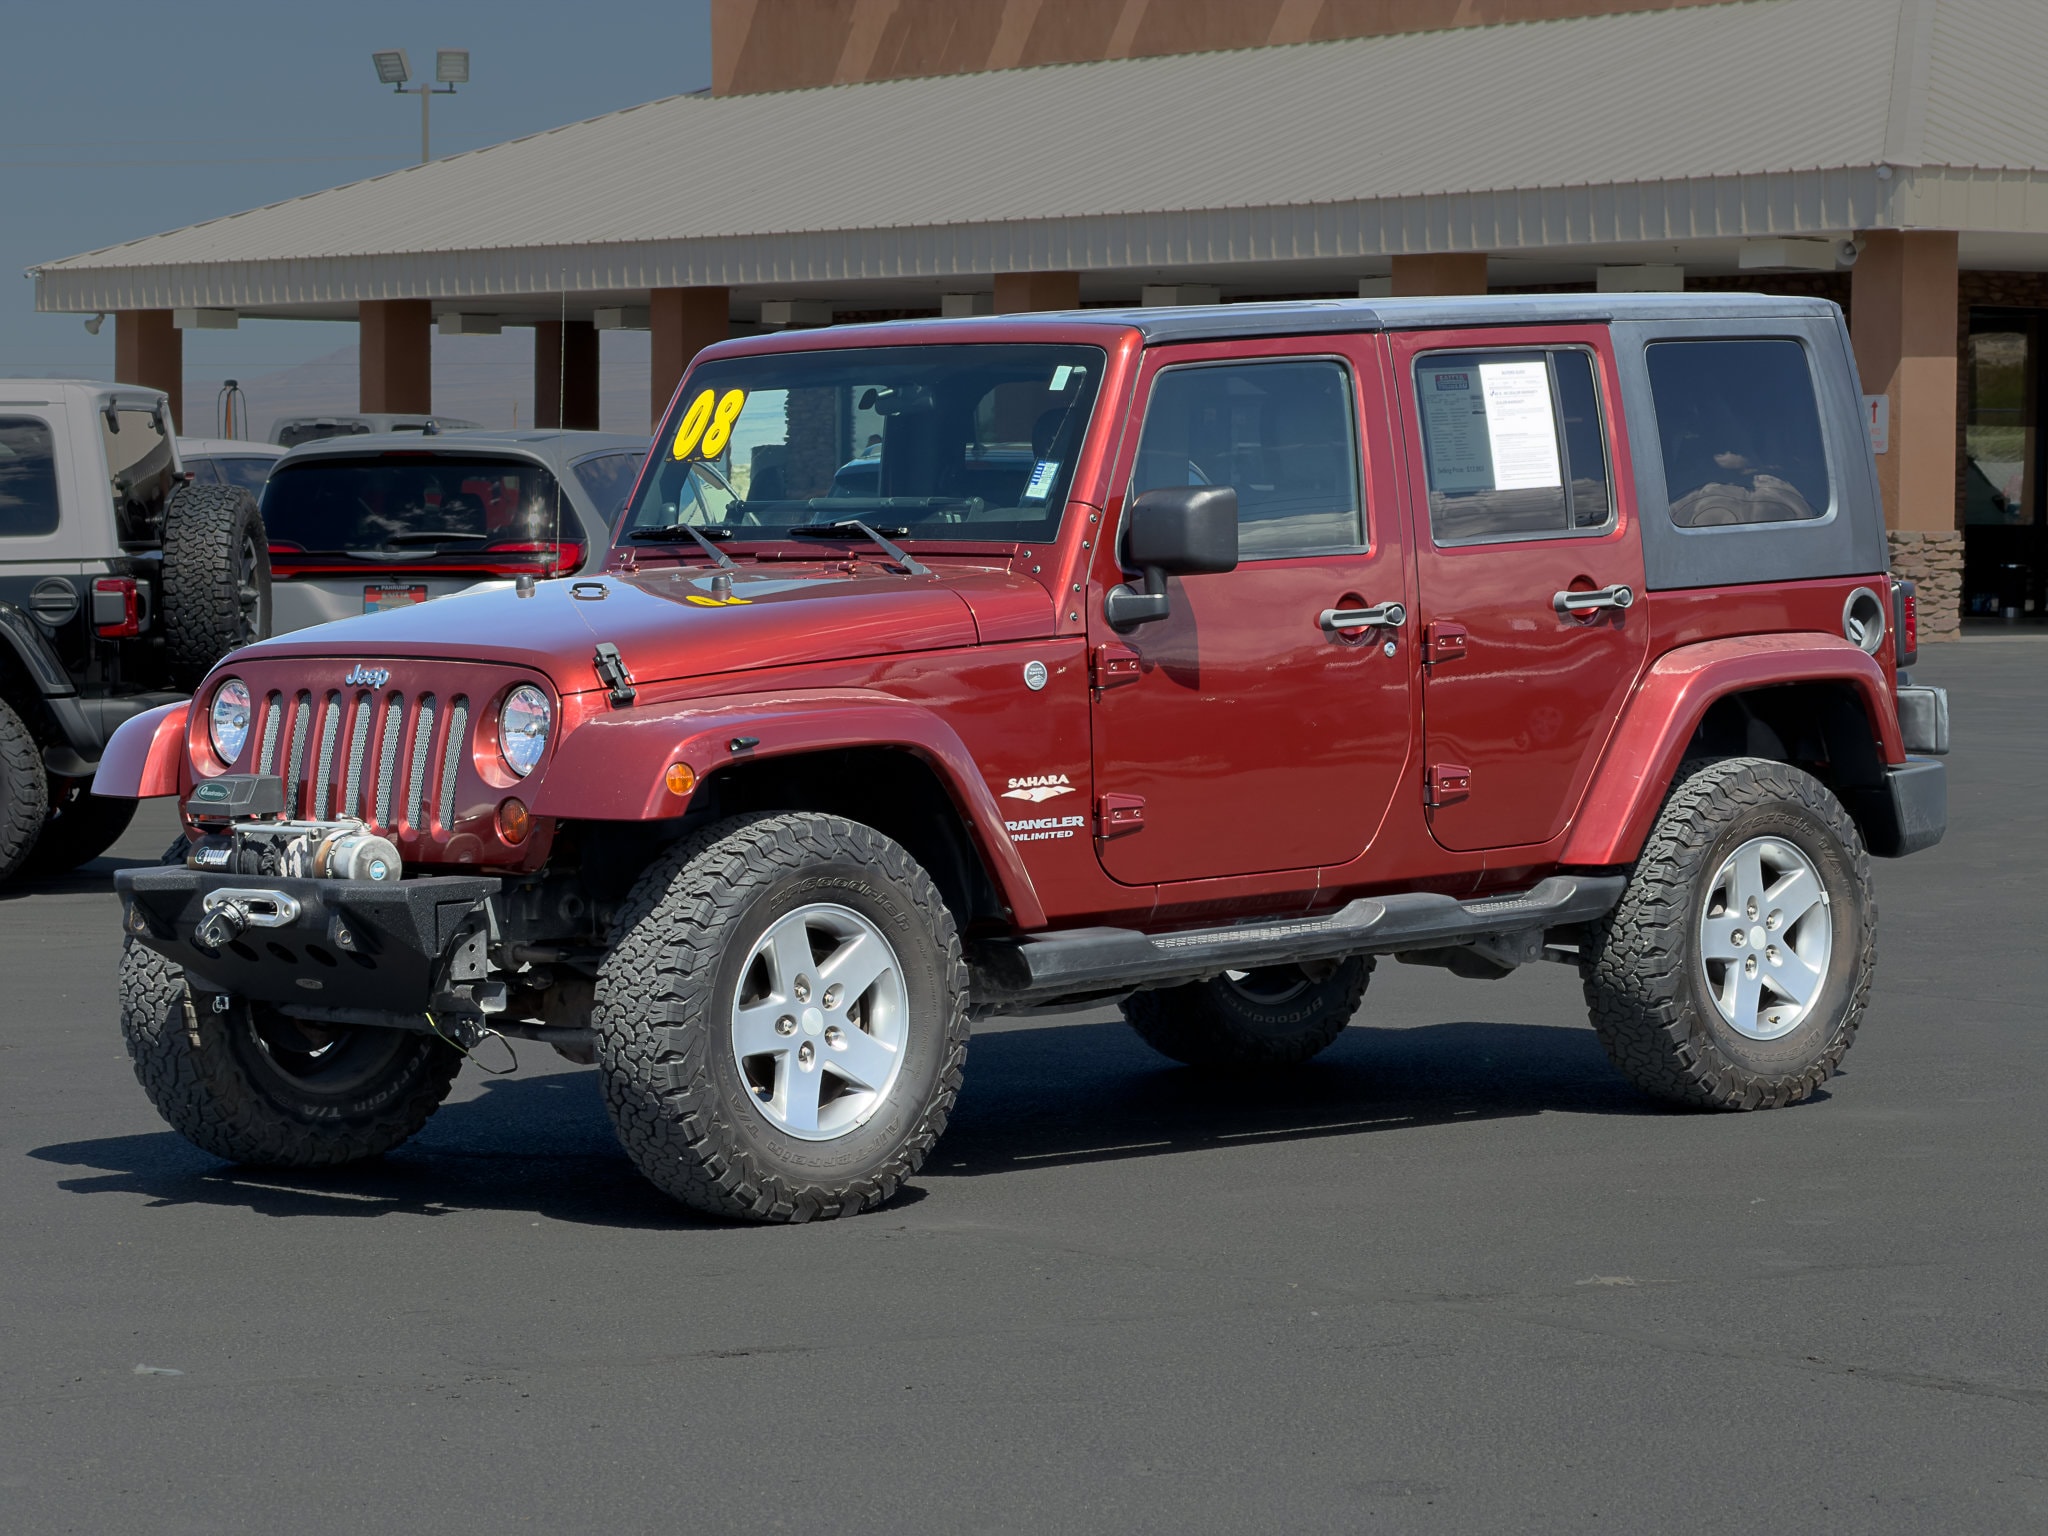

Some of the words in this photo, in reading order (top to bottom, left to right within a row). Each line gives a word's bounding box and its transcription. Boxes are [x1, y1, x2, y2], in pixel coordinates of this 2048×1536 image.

[673, 389, 744, 460] 08
[345, 664, 389, 689] Jeep
[1008, 774, 1069, 788] SAHARA
[1005, 816, 1084, 831] RANGLER
